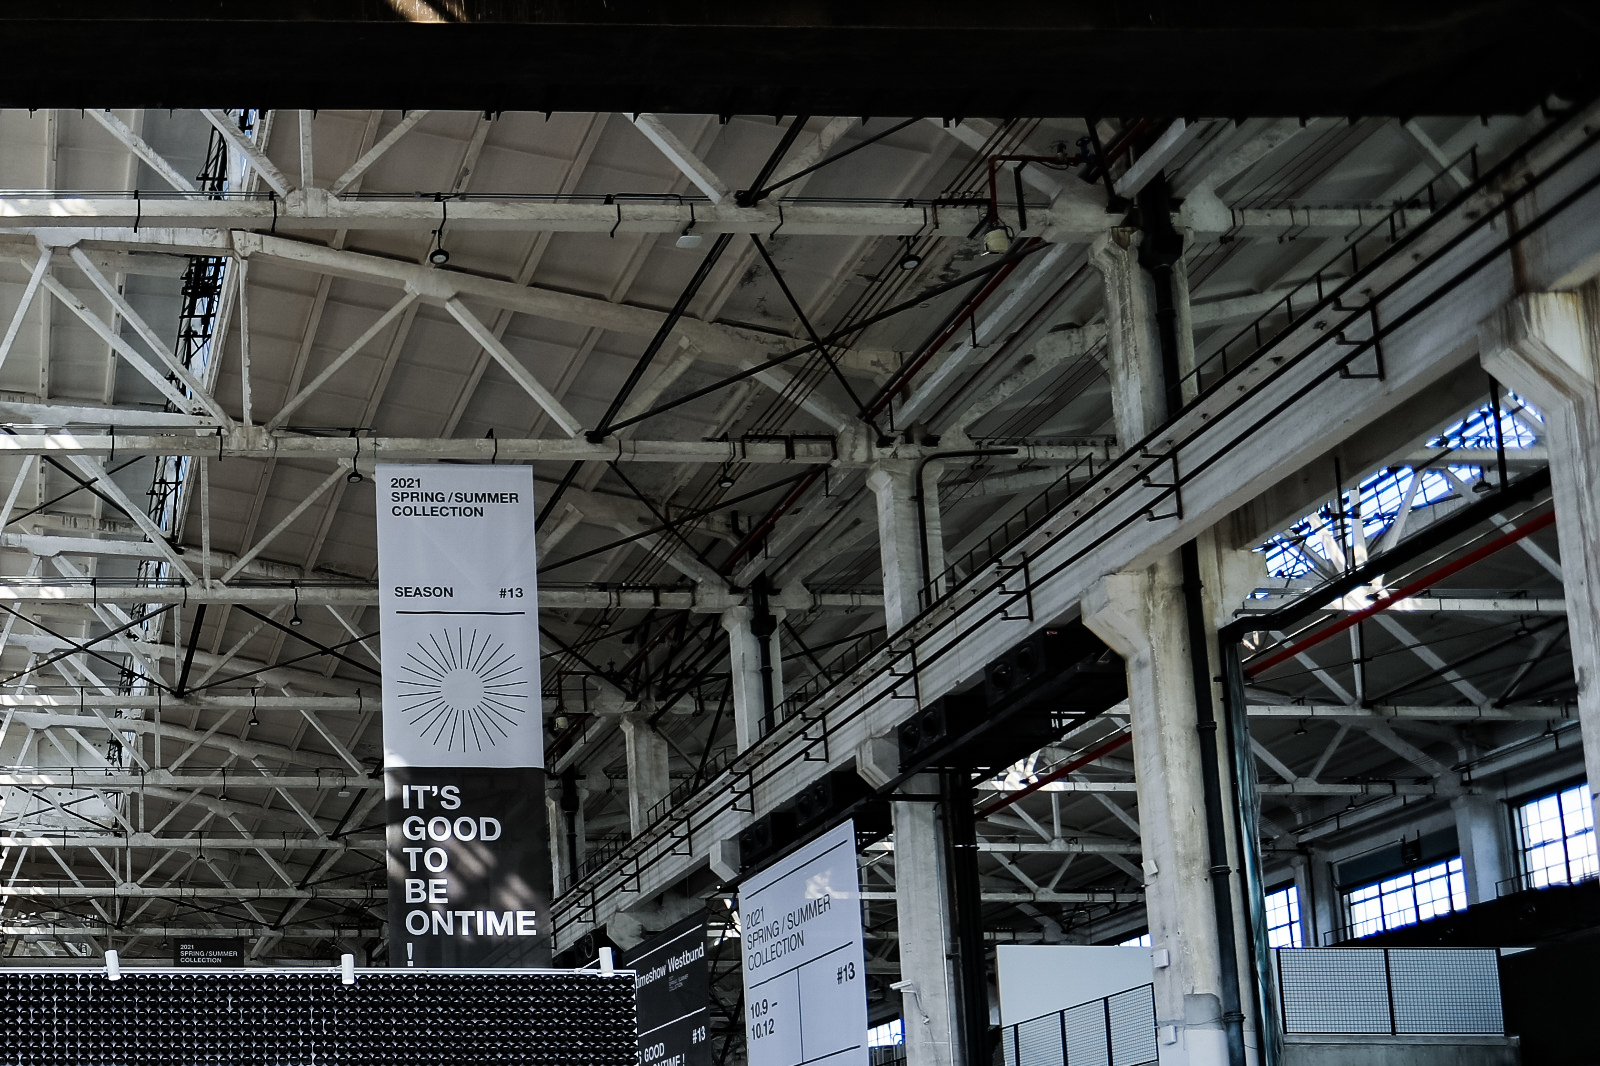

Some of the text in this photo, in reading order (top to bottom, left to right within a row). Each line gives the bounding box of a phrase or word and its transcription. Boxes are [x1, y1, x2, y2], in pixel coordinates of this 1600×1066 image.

[390, 478, 421, 489] 2021
[391, 491, 445, 503] SPRING
[391, 505, 484, 518] COLLECTION
[394, 586, 524, 599] SEASON #13
[402, 815, 502, 842] GOOD
[402, 847, 449, 873] TO
[405, 878, 449, 904] BE
[405, 909, 537, 936] ONTIME
[746, 906, 765, 930] 2021
[747, 920, 780, 951] SPRING
[787, 893, 831, 931] SUMMER
[406, 942, 414, 967] !
[748, 930, 805, 971] COLLECTION
[636, 964, 667, 989] timeshow
[667, 941, 705, 973] Westbund
[837, 961, 856, 985] #13
[750, 999, 768, 1019] 10.9
[692, 1025, 706, 1044] #13
[751, 1018, 775, 1040] 10.12
[644, 1042, 665, 1062] GOOD
